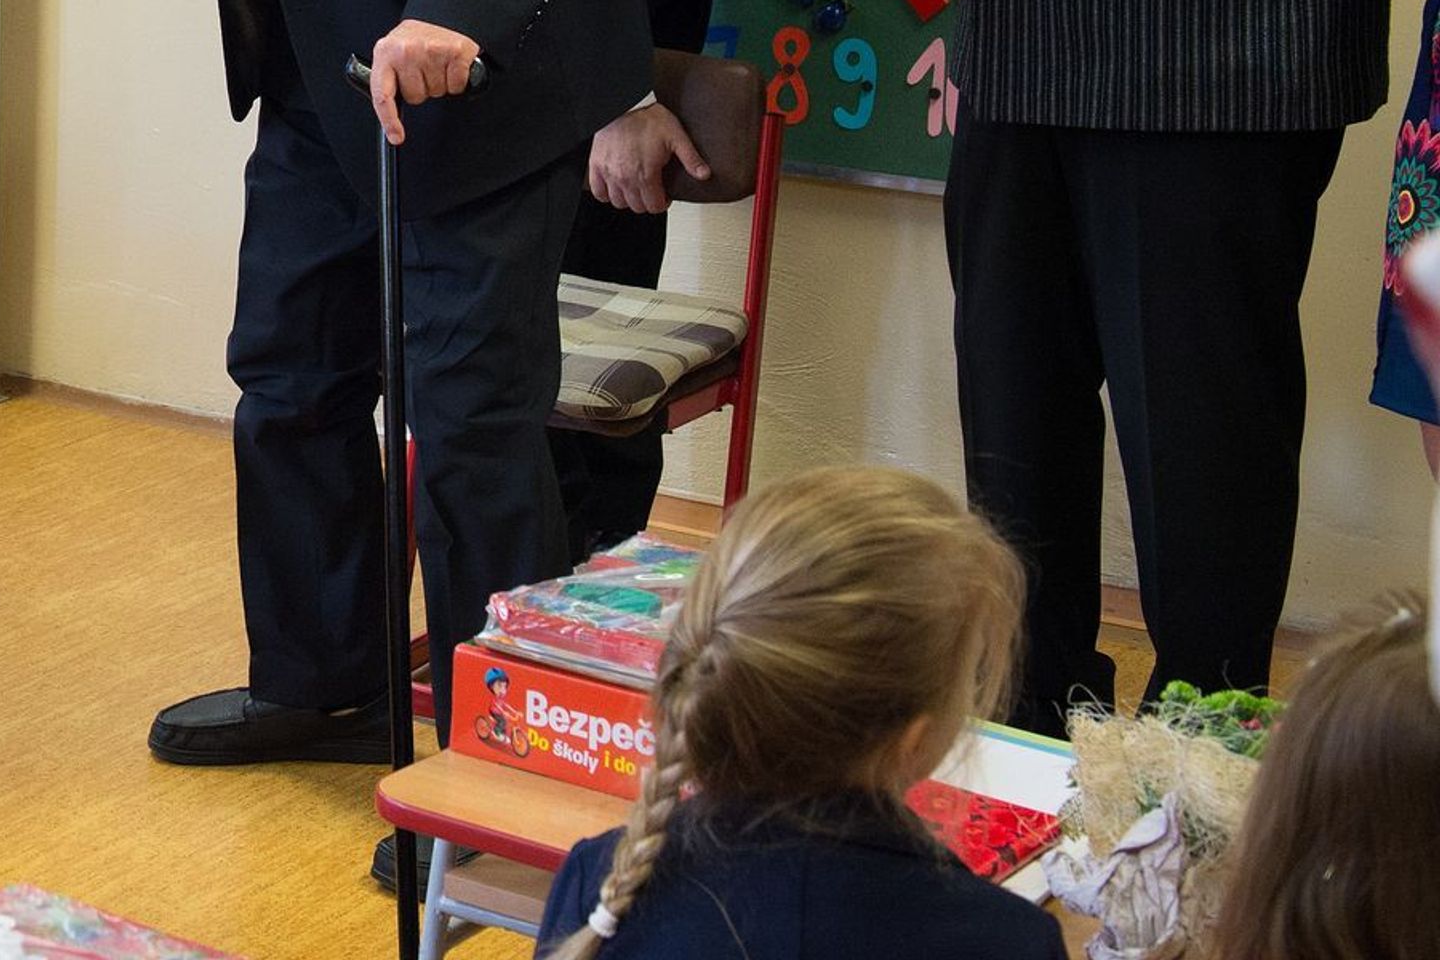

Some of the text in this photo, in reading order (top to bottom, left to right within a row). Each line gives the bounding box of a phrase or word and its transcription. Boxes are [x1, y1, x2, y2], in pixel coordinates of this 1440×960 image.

[766, 26, 812, 126] 8
[833, 38, 878, 130] 9
[906, 37, 959, 138] 1
[525, 689, 657, 756] Bezpeč
[527, 727, 550, 752] Do
[552, 738, 600, 775] školy
[613, 755, 636, 776] do
